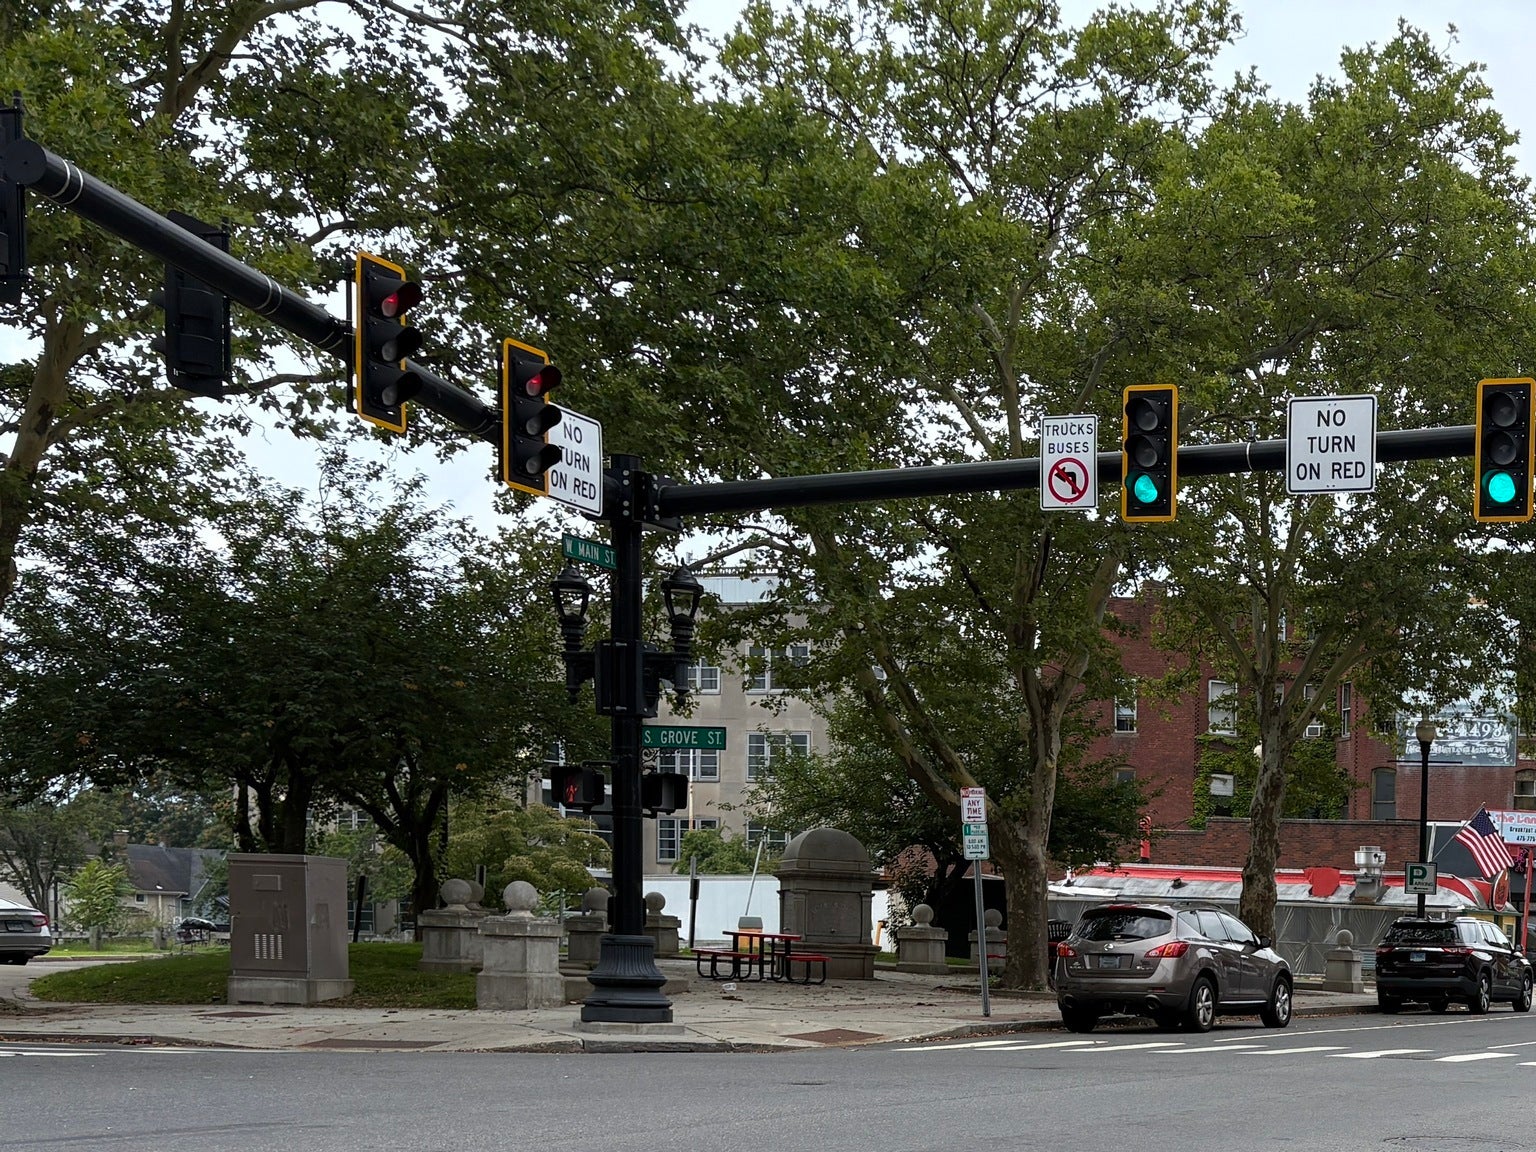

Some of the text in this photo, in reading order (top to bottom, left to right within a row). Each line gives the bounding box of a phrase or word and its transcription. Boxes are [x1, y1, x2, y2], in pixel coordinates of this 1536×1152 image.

[1317, 409, 1346, 427] NO
[563, 421, 583, 444] NO
[1045, 423, 1093, 437] TRUCKS
[1048, 441, 1089, 454] BUSES
[1307, 435, 1355, 454] TURN
[559, 446, 590, 473] TURN
[1296, 461, 1366, 480] ON RED
[551, 469, 596, 500] ON RED
[578, 543, 600, 561] MAIN
[660, 730, 698, 744] GROVE
[967, 807, 982, 815] TIME
